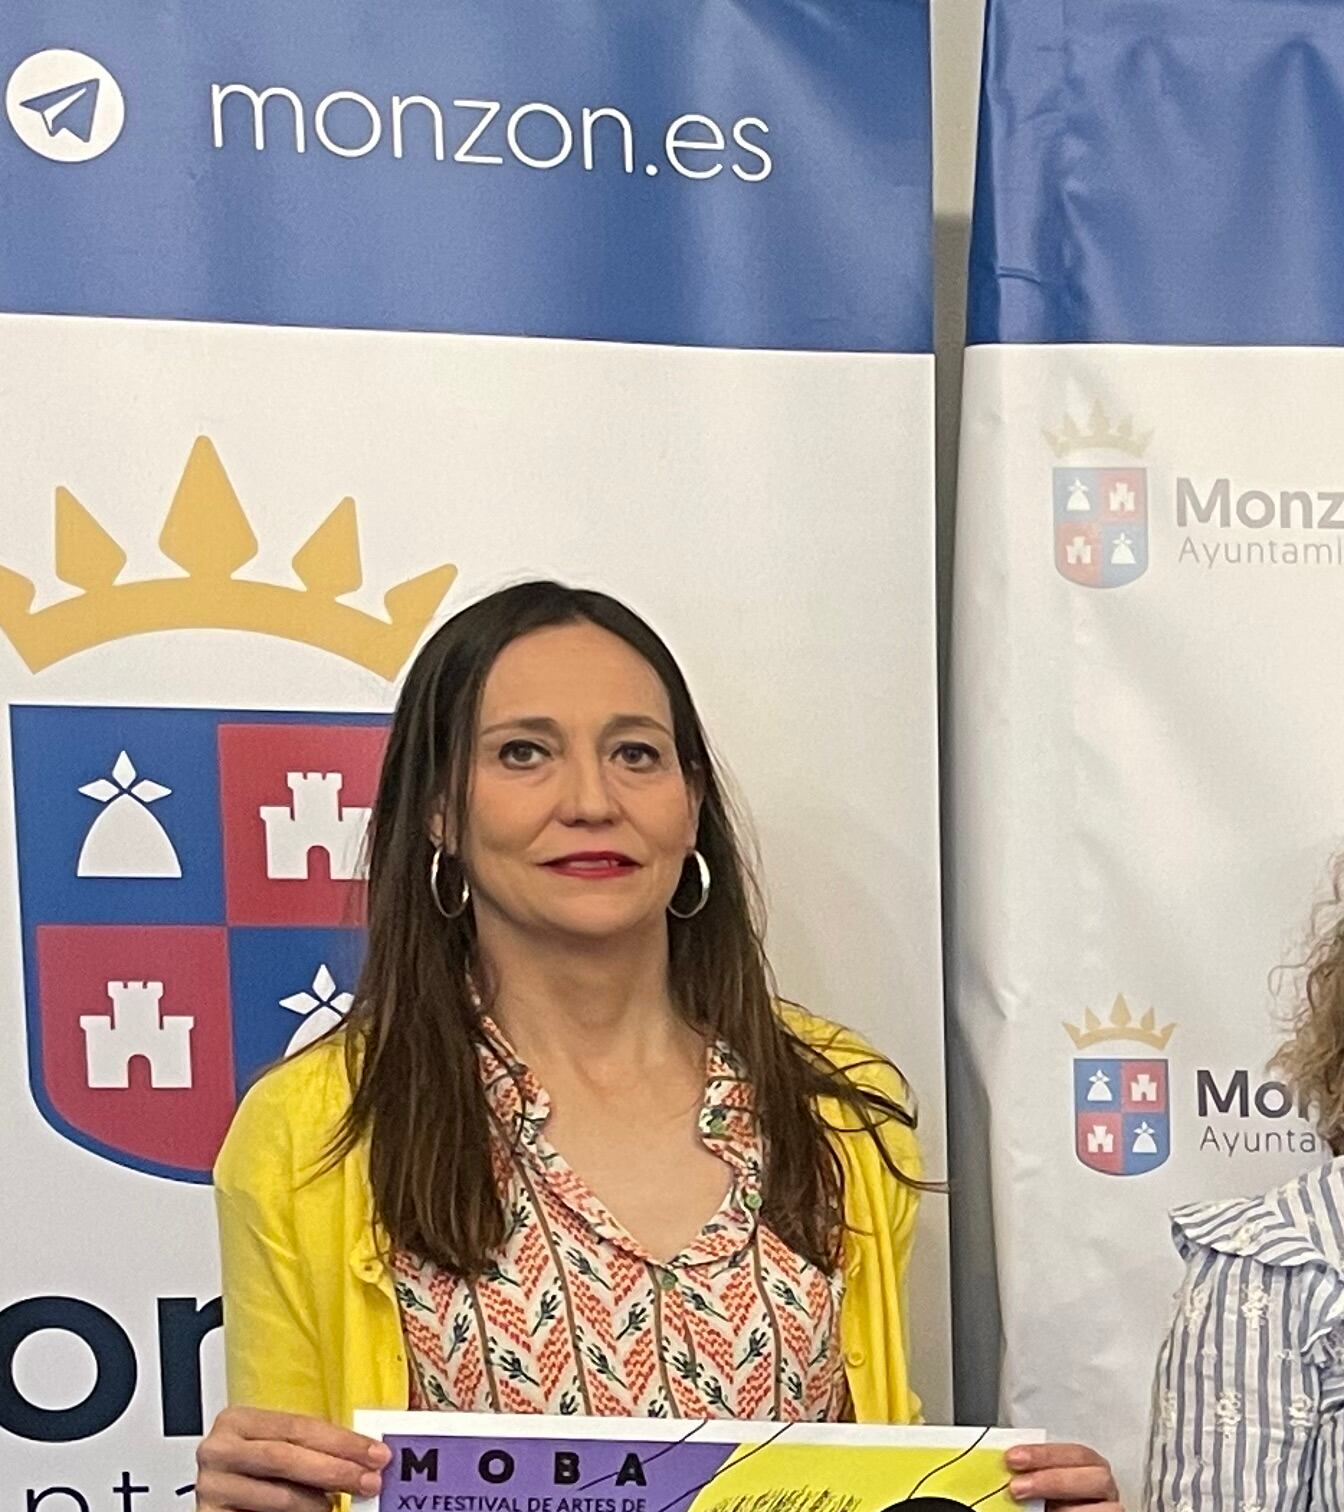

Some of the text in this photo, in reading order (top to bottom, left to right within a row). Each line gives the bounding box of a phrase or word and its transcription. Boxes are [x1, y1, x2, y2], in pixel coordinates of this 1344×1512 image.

[211, 80, 773, 182] monzon.es
[400, 1448, 647, 1487] MOBA
[397, 1495, 427, 1511] XV
[432, 1496, 521, 1512] FESTIVAL
[528, 1498, 553, 1512] DE
